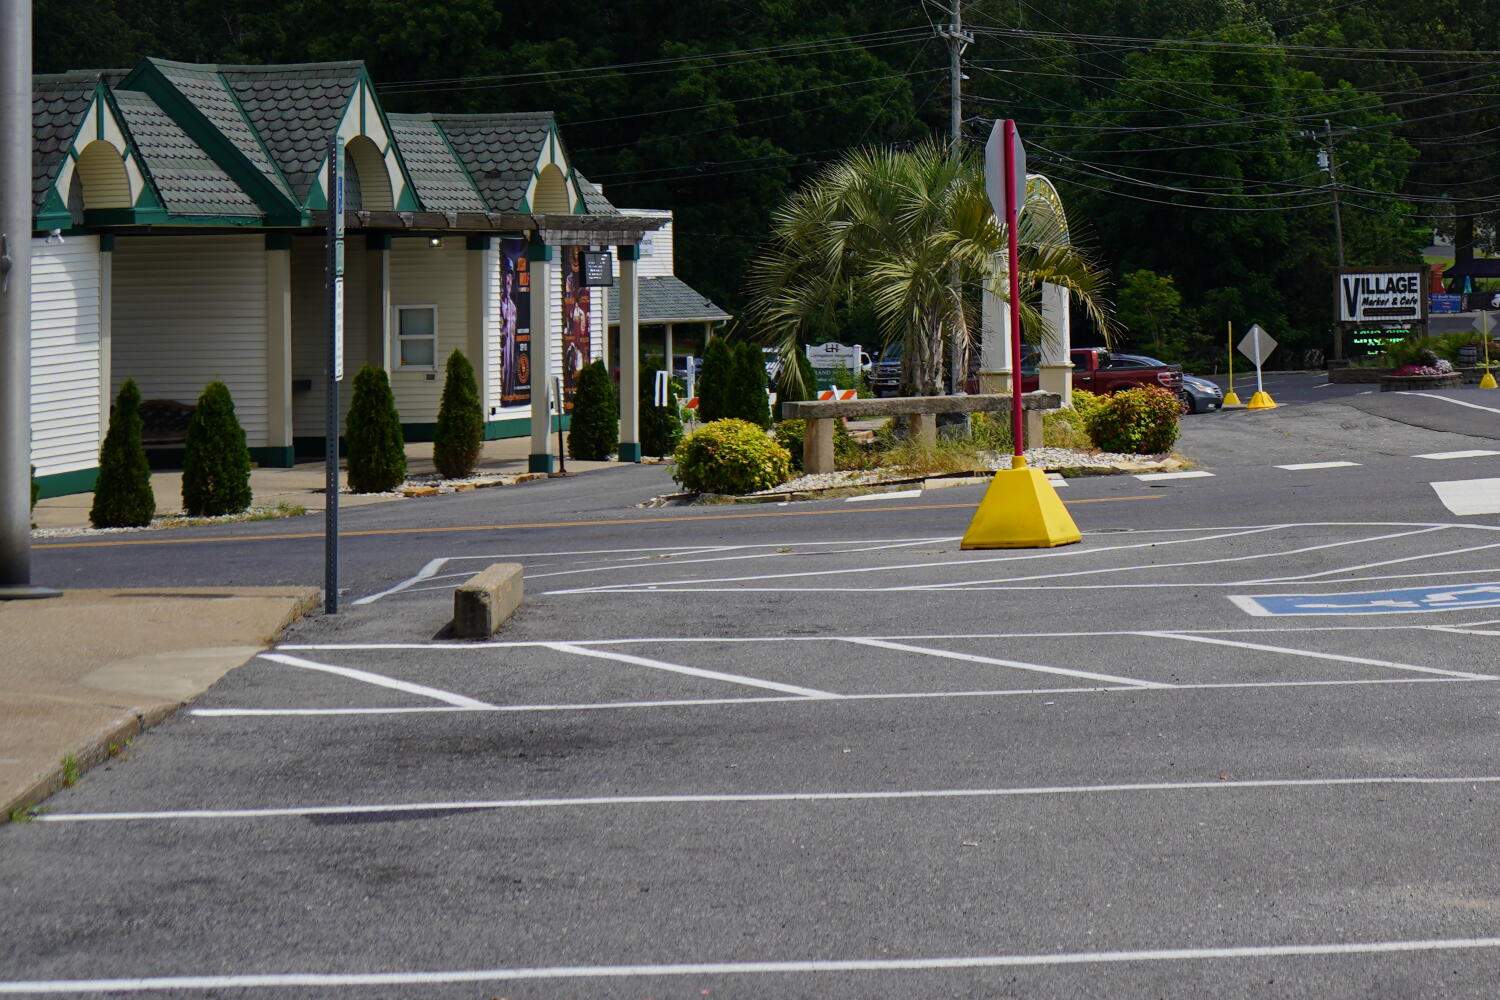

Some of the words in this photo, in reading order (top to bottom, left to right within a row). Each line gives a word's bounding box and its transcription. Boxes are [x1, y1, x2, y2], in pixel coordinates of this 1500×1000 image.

[1343, 276, 1418, 317] VILLAGE
[1362, 297, 1389, 306] Market
[1399, 296, 1418, 305] Cafe
